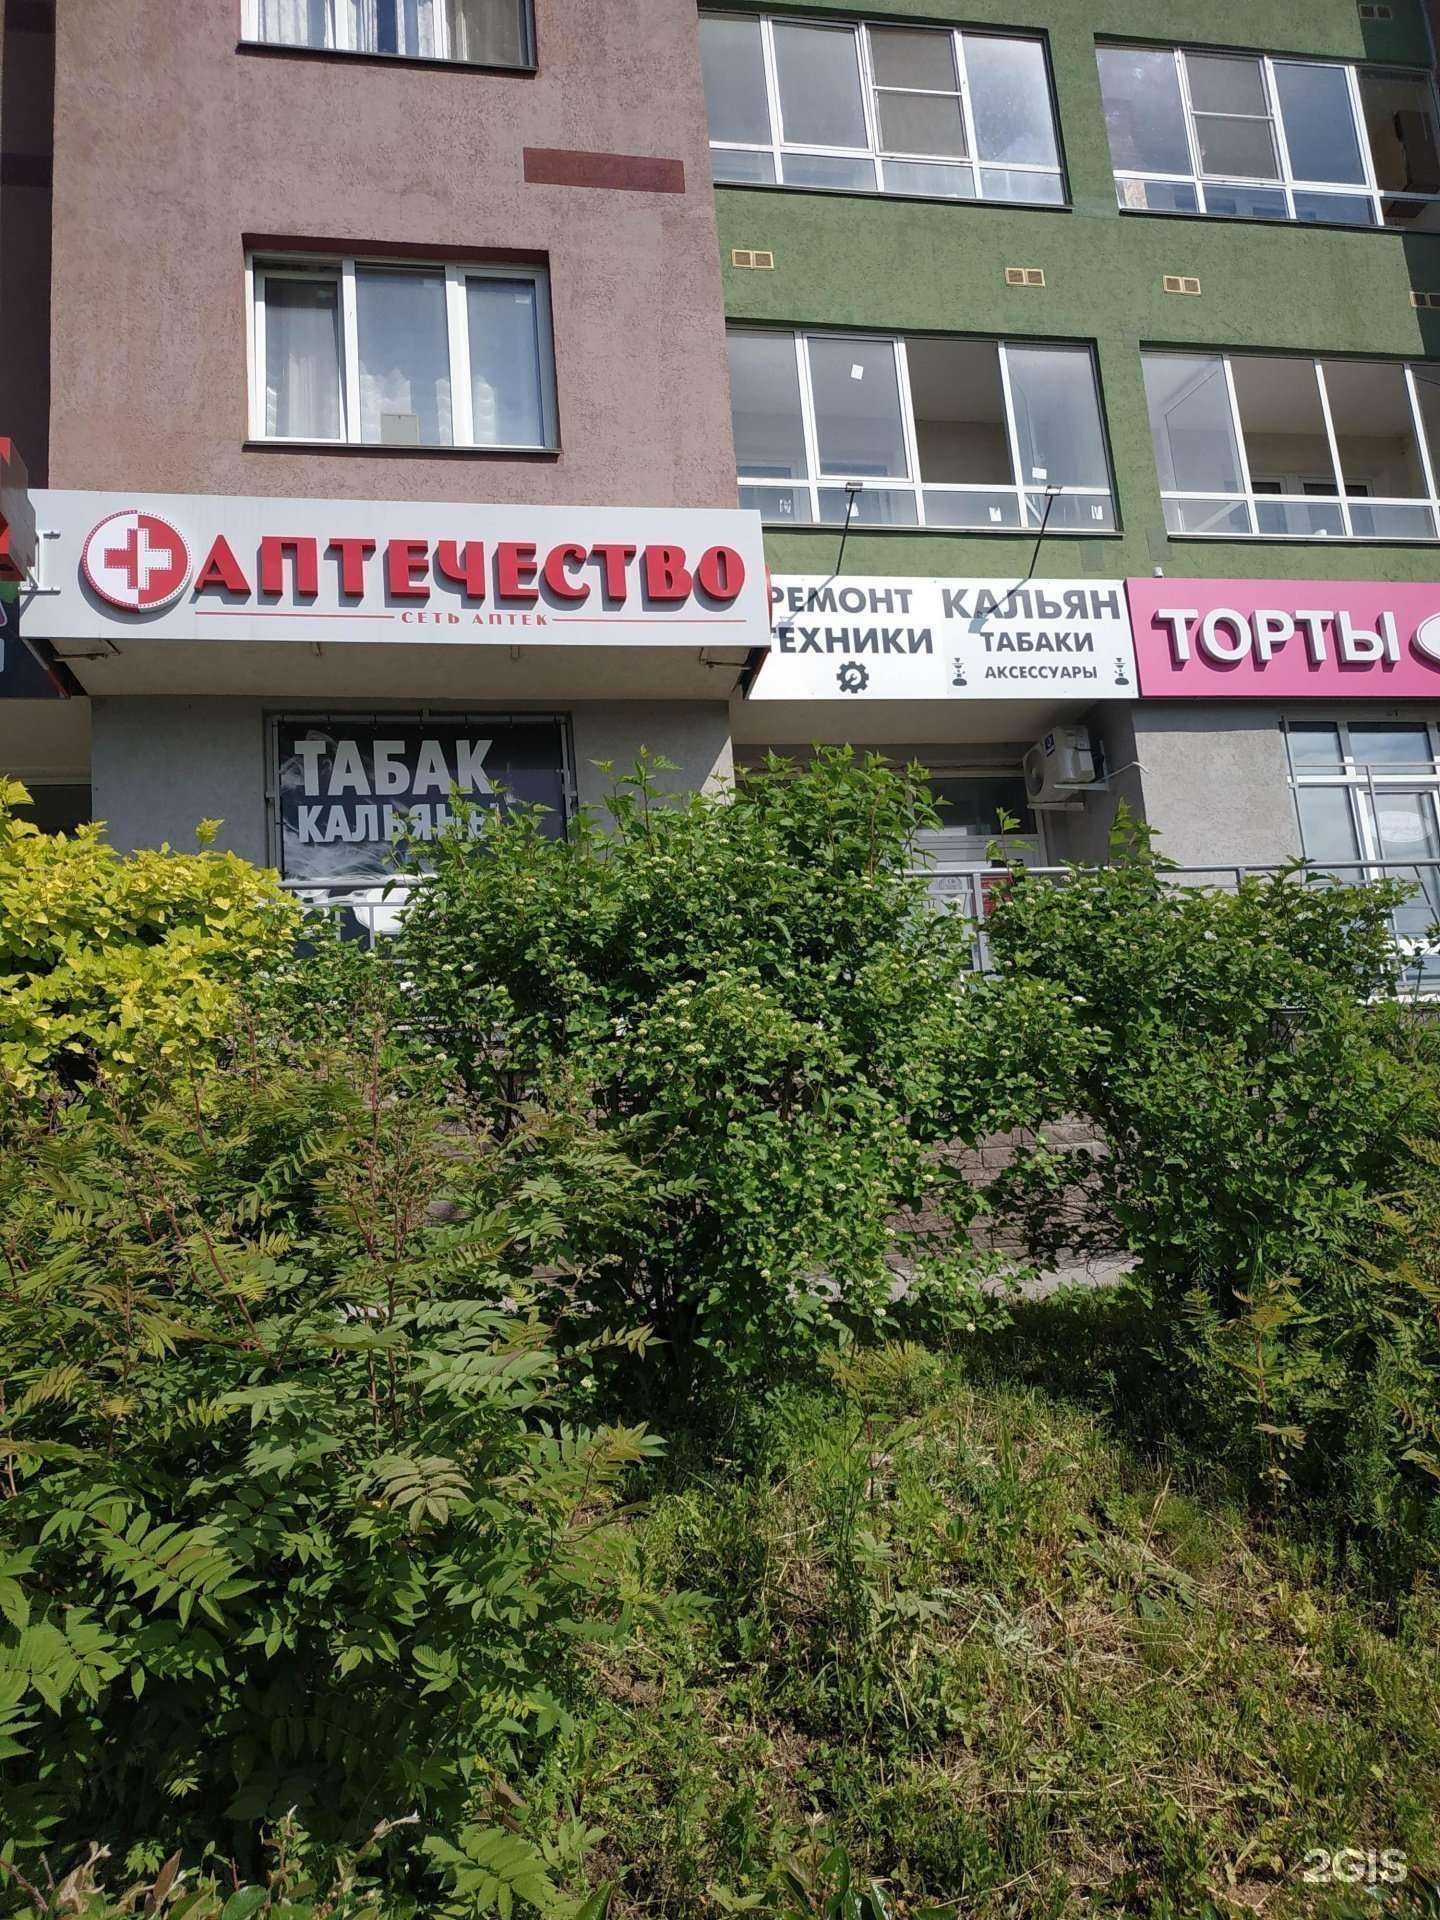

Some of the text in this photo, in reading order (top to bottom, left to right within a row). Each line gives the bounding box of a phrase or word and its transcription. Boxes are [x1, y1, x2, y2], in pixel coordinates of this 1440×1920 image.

[195, 533, 746, 601] АПТЕЧЕСТВО
[401, 611, 549, 626] СЕТЬ АПТЕК
[941, 588, 1121, 620] КАЛЬЯН
[770, 627, 934, 654] ЕХНИКИ
[980, 632, 1095, 653] ТАБАКИ
[1154, 608, 1401, 665] ТОРТЫ
[984, 665, 1098, 680] АКСЕССУАРЫ
[295, 739, 495, 796] ТАБАК
